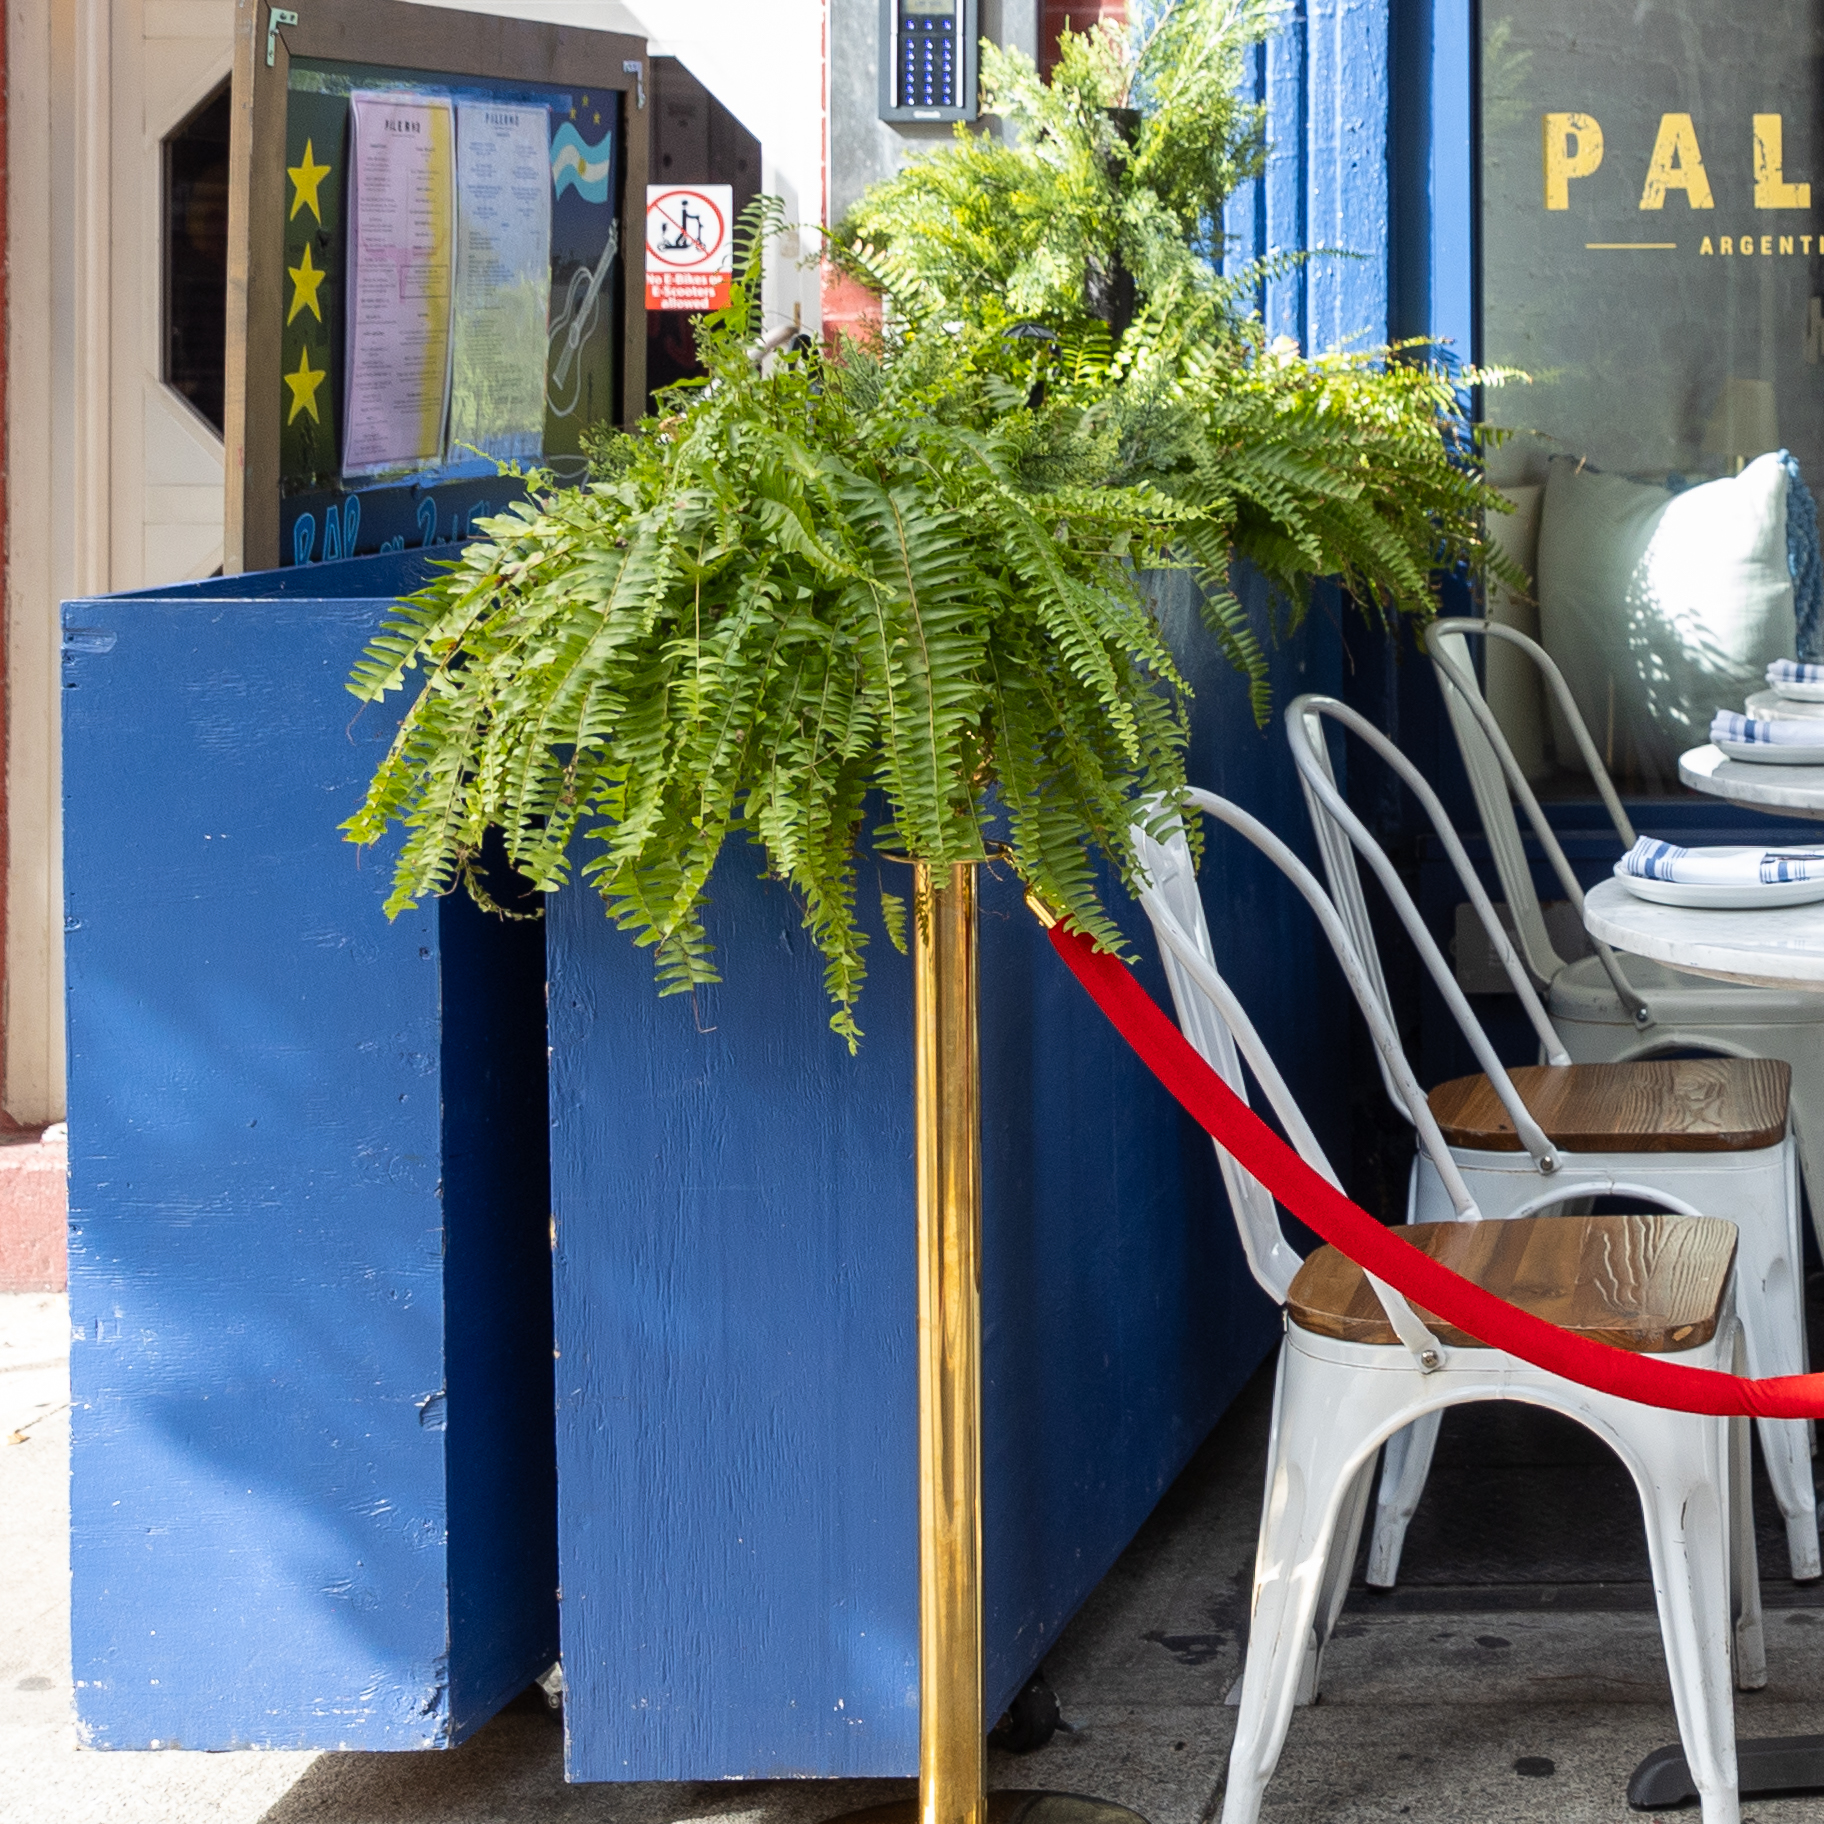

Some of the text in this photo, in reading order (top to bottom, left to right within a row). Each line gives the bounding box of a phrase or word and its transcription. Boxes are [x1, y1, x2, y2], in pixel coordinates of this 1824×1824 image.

[646, 274, 663, 285] No
[652, 286, 716, 297] E-Scooters
[660, 298, 709, 309] allowed
